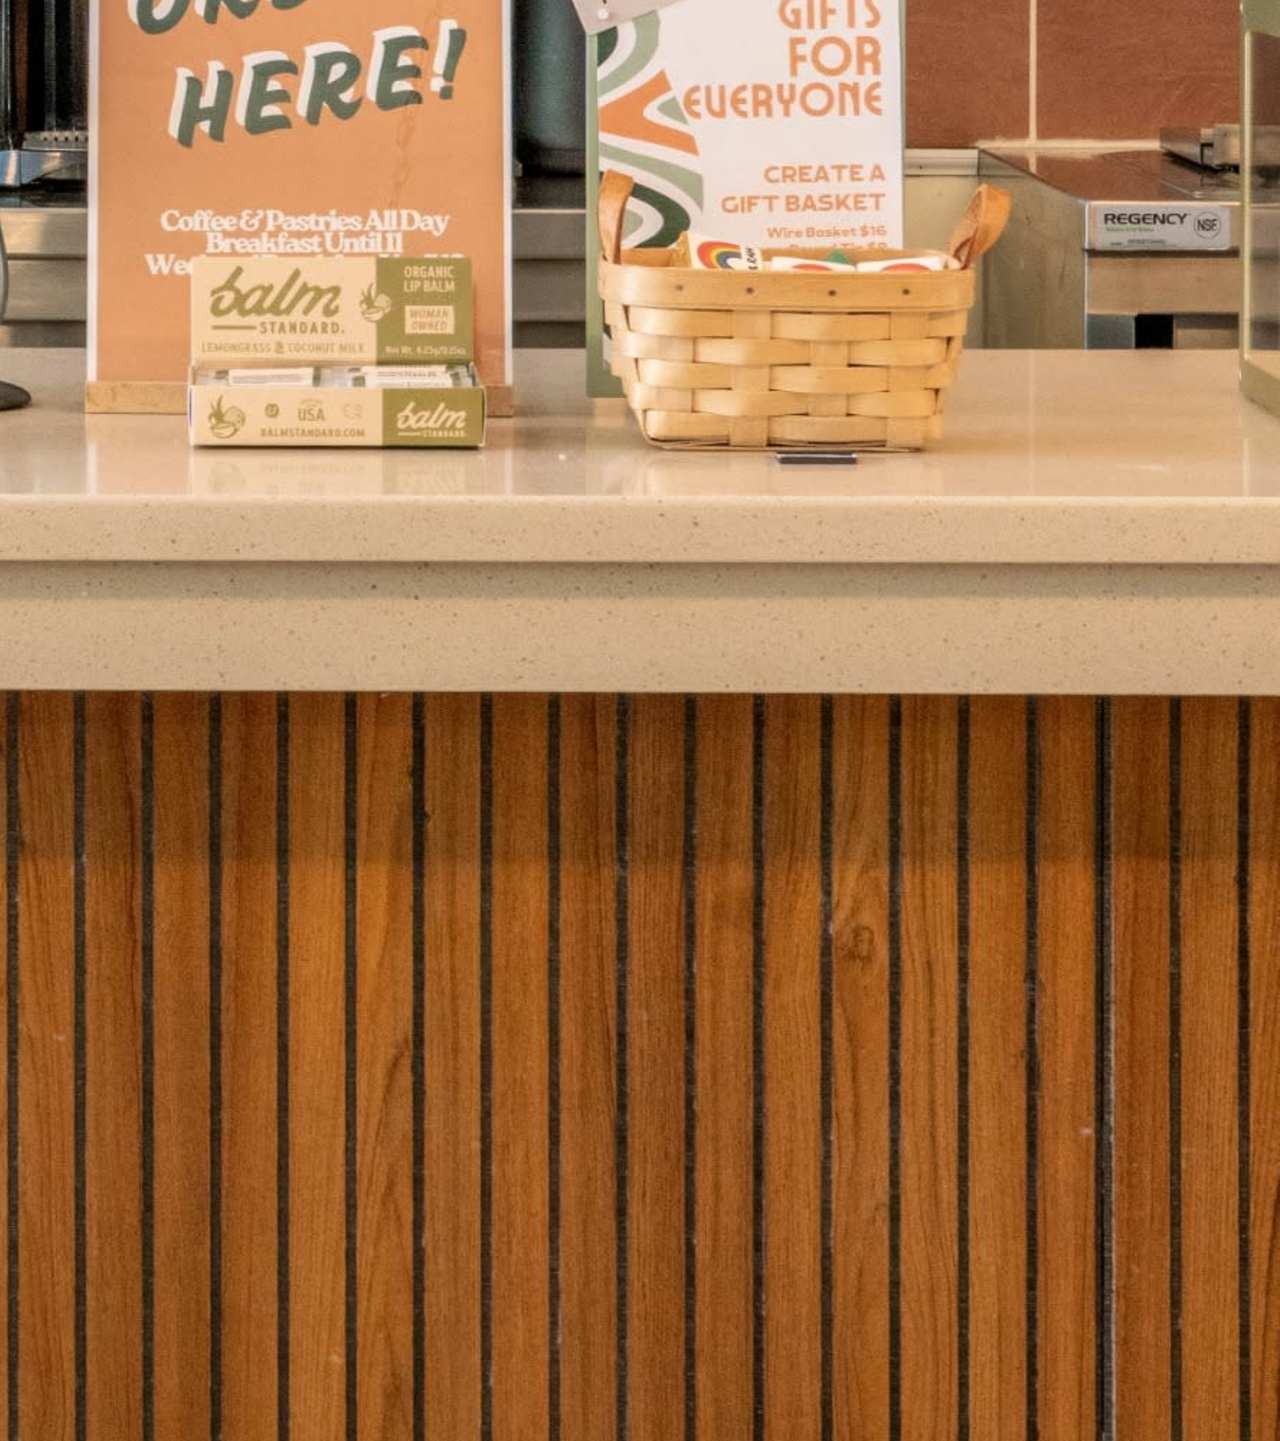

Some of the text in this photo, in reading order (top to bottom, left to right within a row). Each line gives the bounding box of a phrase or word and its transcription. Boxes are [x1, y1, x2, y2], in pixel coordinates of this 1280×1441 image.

[789, 36, 881, 77] FOR
[167, 19, 467, 149] HERE!
[764, 164, 886, 183] CREATE A
[721, 193, 886, 214] GIFT BASKET
[160, 209, 450, 236] Coffee & Pastries All Day
[1103, 213, 1189, 226] REGENCY
[767, 225, 887, 238] Wire Basket $16
[205, 232, 404, 254] Breakfast Until 11
[403, 266, 455, 278] ORGANIC
[209, 265, 342, 319] balm
[403, 280, 456, 293] LIP BALM
[201, 342, 270, 354] LEMONGRASS
[288, 342, 336, 354] COCONUT
[339, 342, 365, 354] MILK
[297, 408, 325, 422] USA
[397, 402, 467, 429] balm
